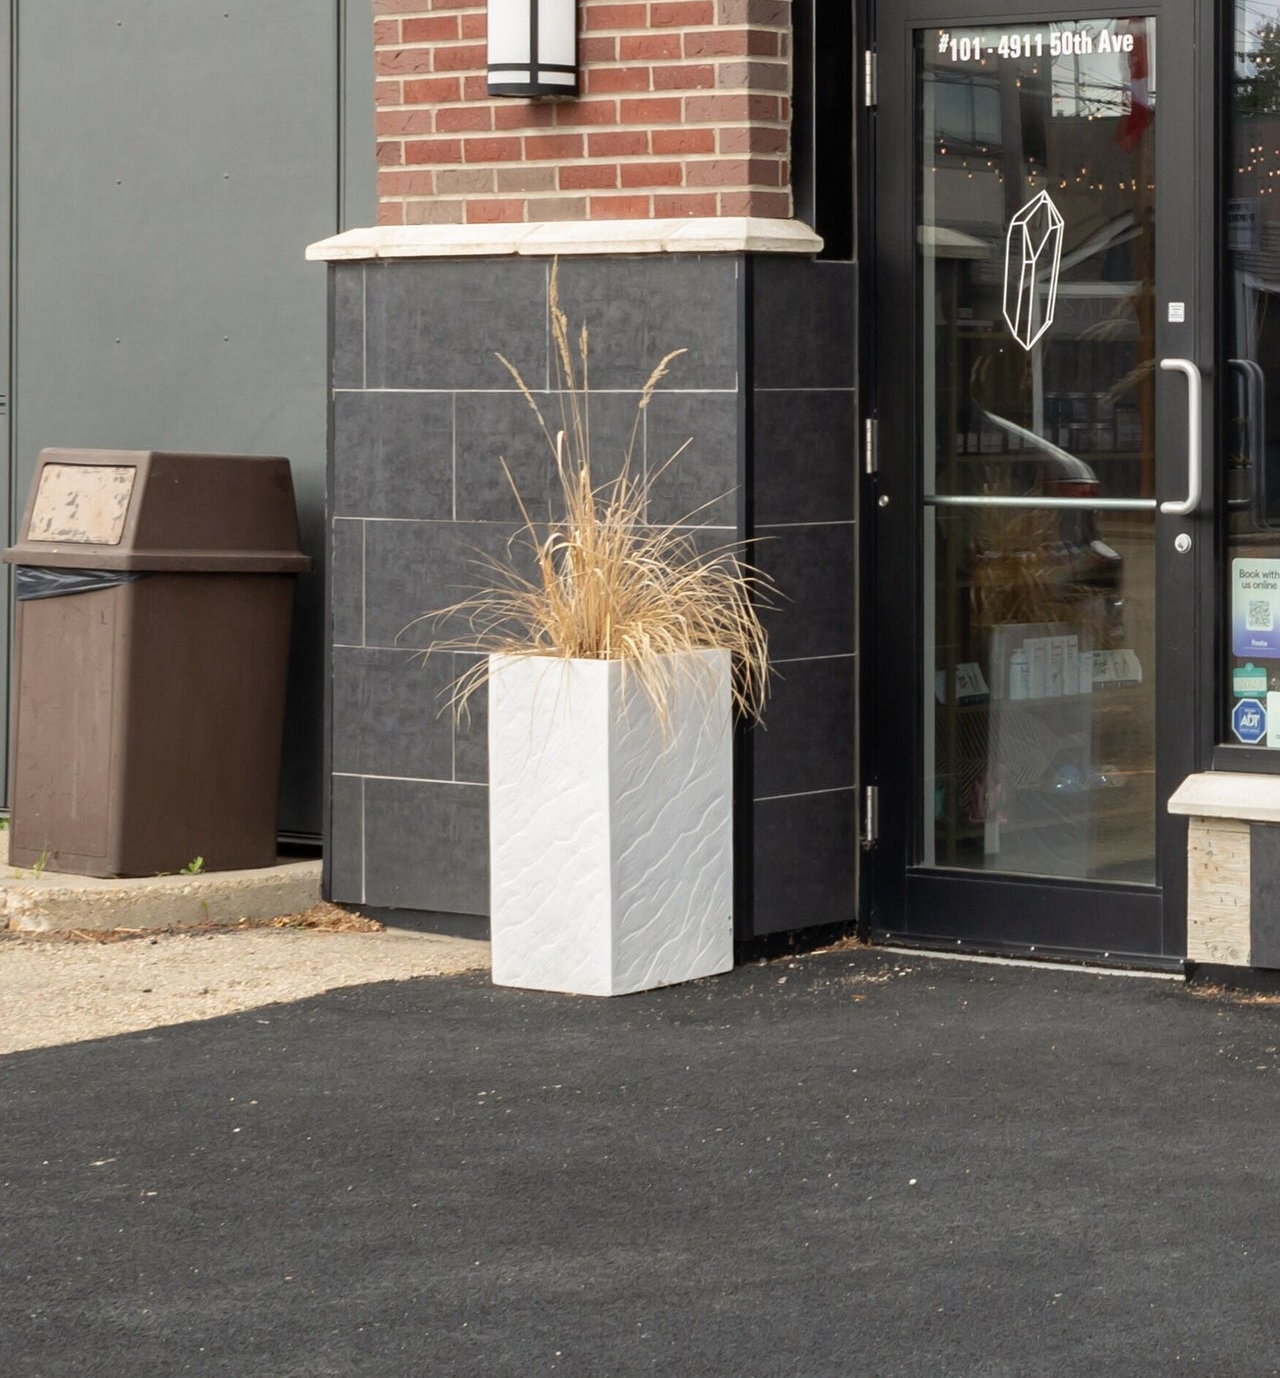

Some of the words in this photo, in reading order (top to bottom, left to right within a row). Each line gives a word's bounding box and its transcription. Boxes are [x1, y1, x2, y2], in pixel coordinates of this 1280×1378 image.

[938, 33, 981, 62] #101
[997, 33, 1043, 59] 4911
[1050, 30, 1093, 57] 50th
[1098, 28, 1134, 54] Ave
[1239, 569, 1260, 579] Book
[1262, 569, 1280, 579] with
[1241, 582, 1252, 590] us
[1252, 580, 1278, 590] online
[1239, 711, 1260, 727] ADT
